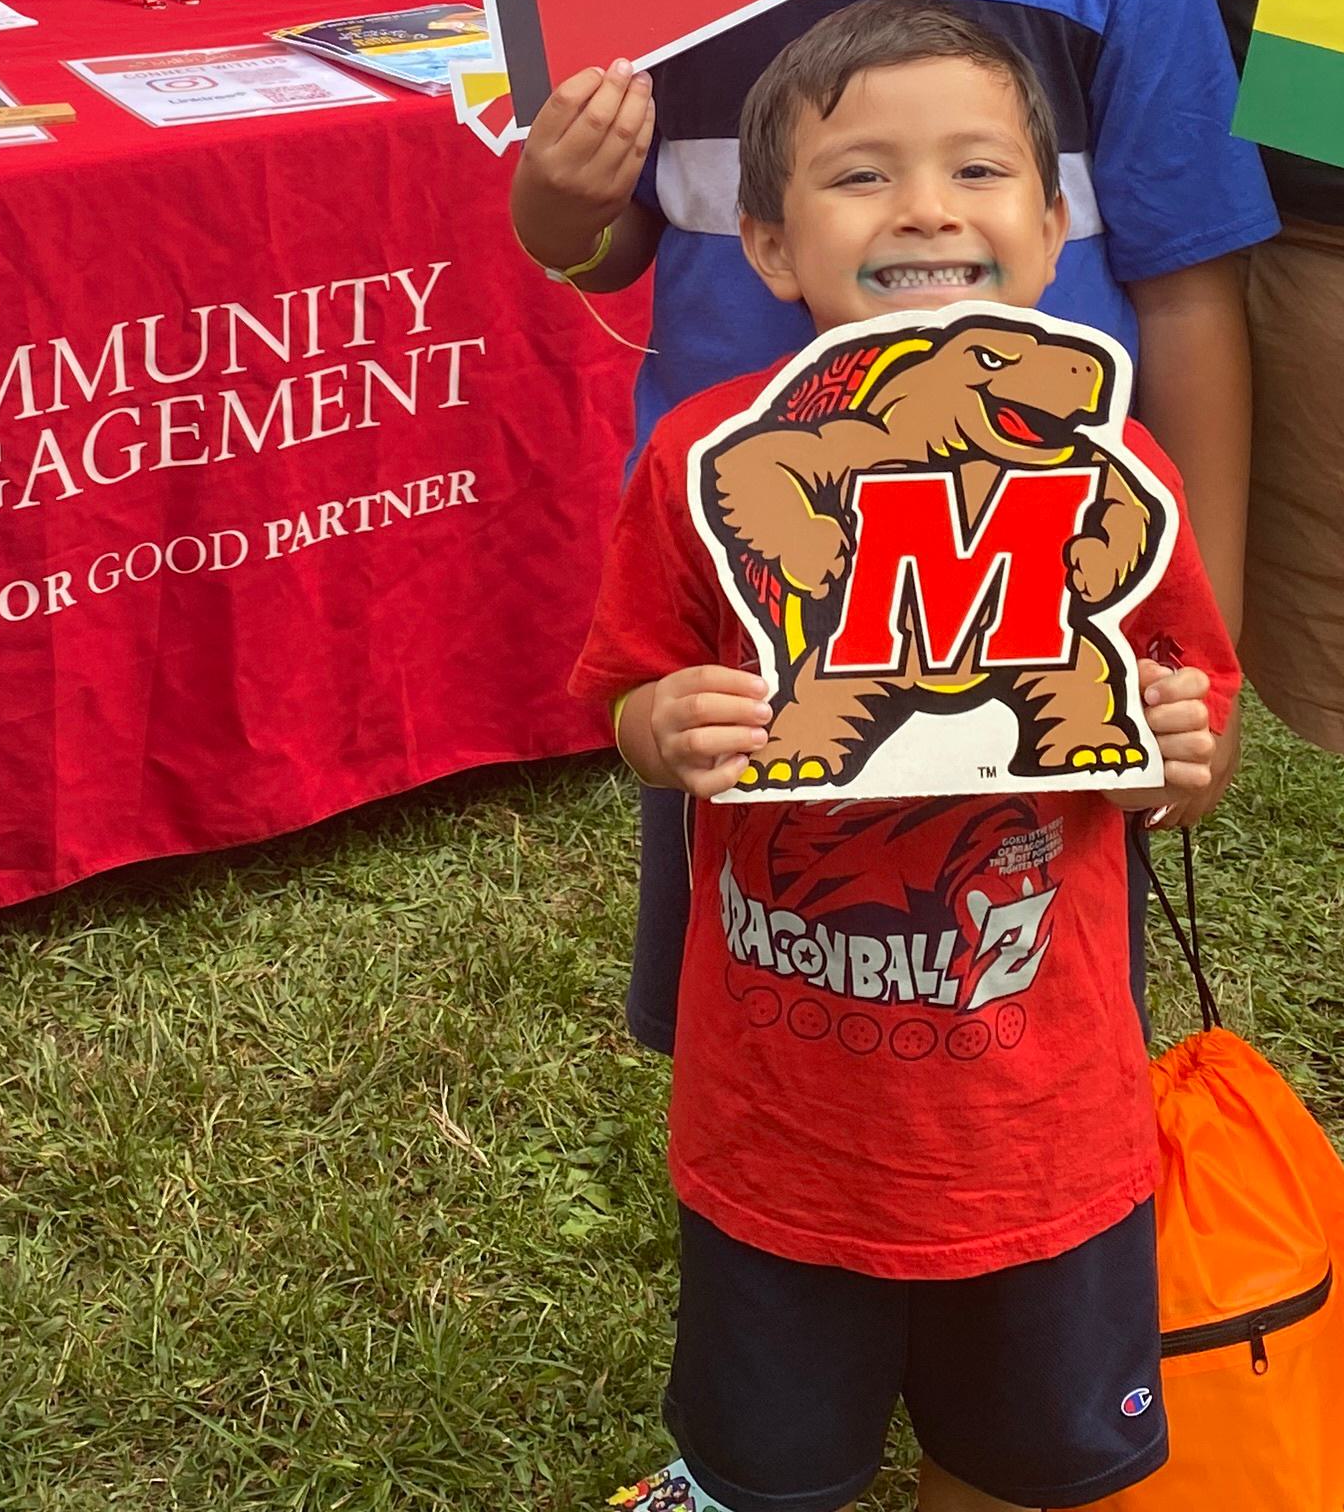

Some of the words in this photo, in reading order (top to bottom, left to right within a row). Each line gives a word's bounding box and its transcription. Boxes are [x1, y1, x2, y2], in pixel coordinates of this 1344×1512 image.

[87, 527, 249, 597] GOOD
[263, 469, 478, 562] PARTNER
[822, 464, 1104, 675] M
[976, 766, 997, 779] TM
[967, 887, 1058, 1010] Z
